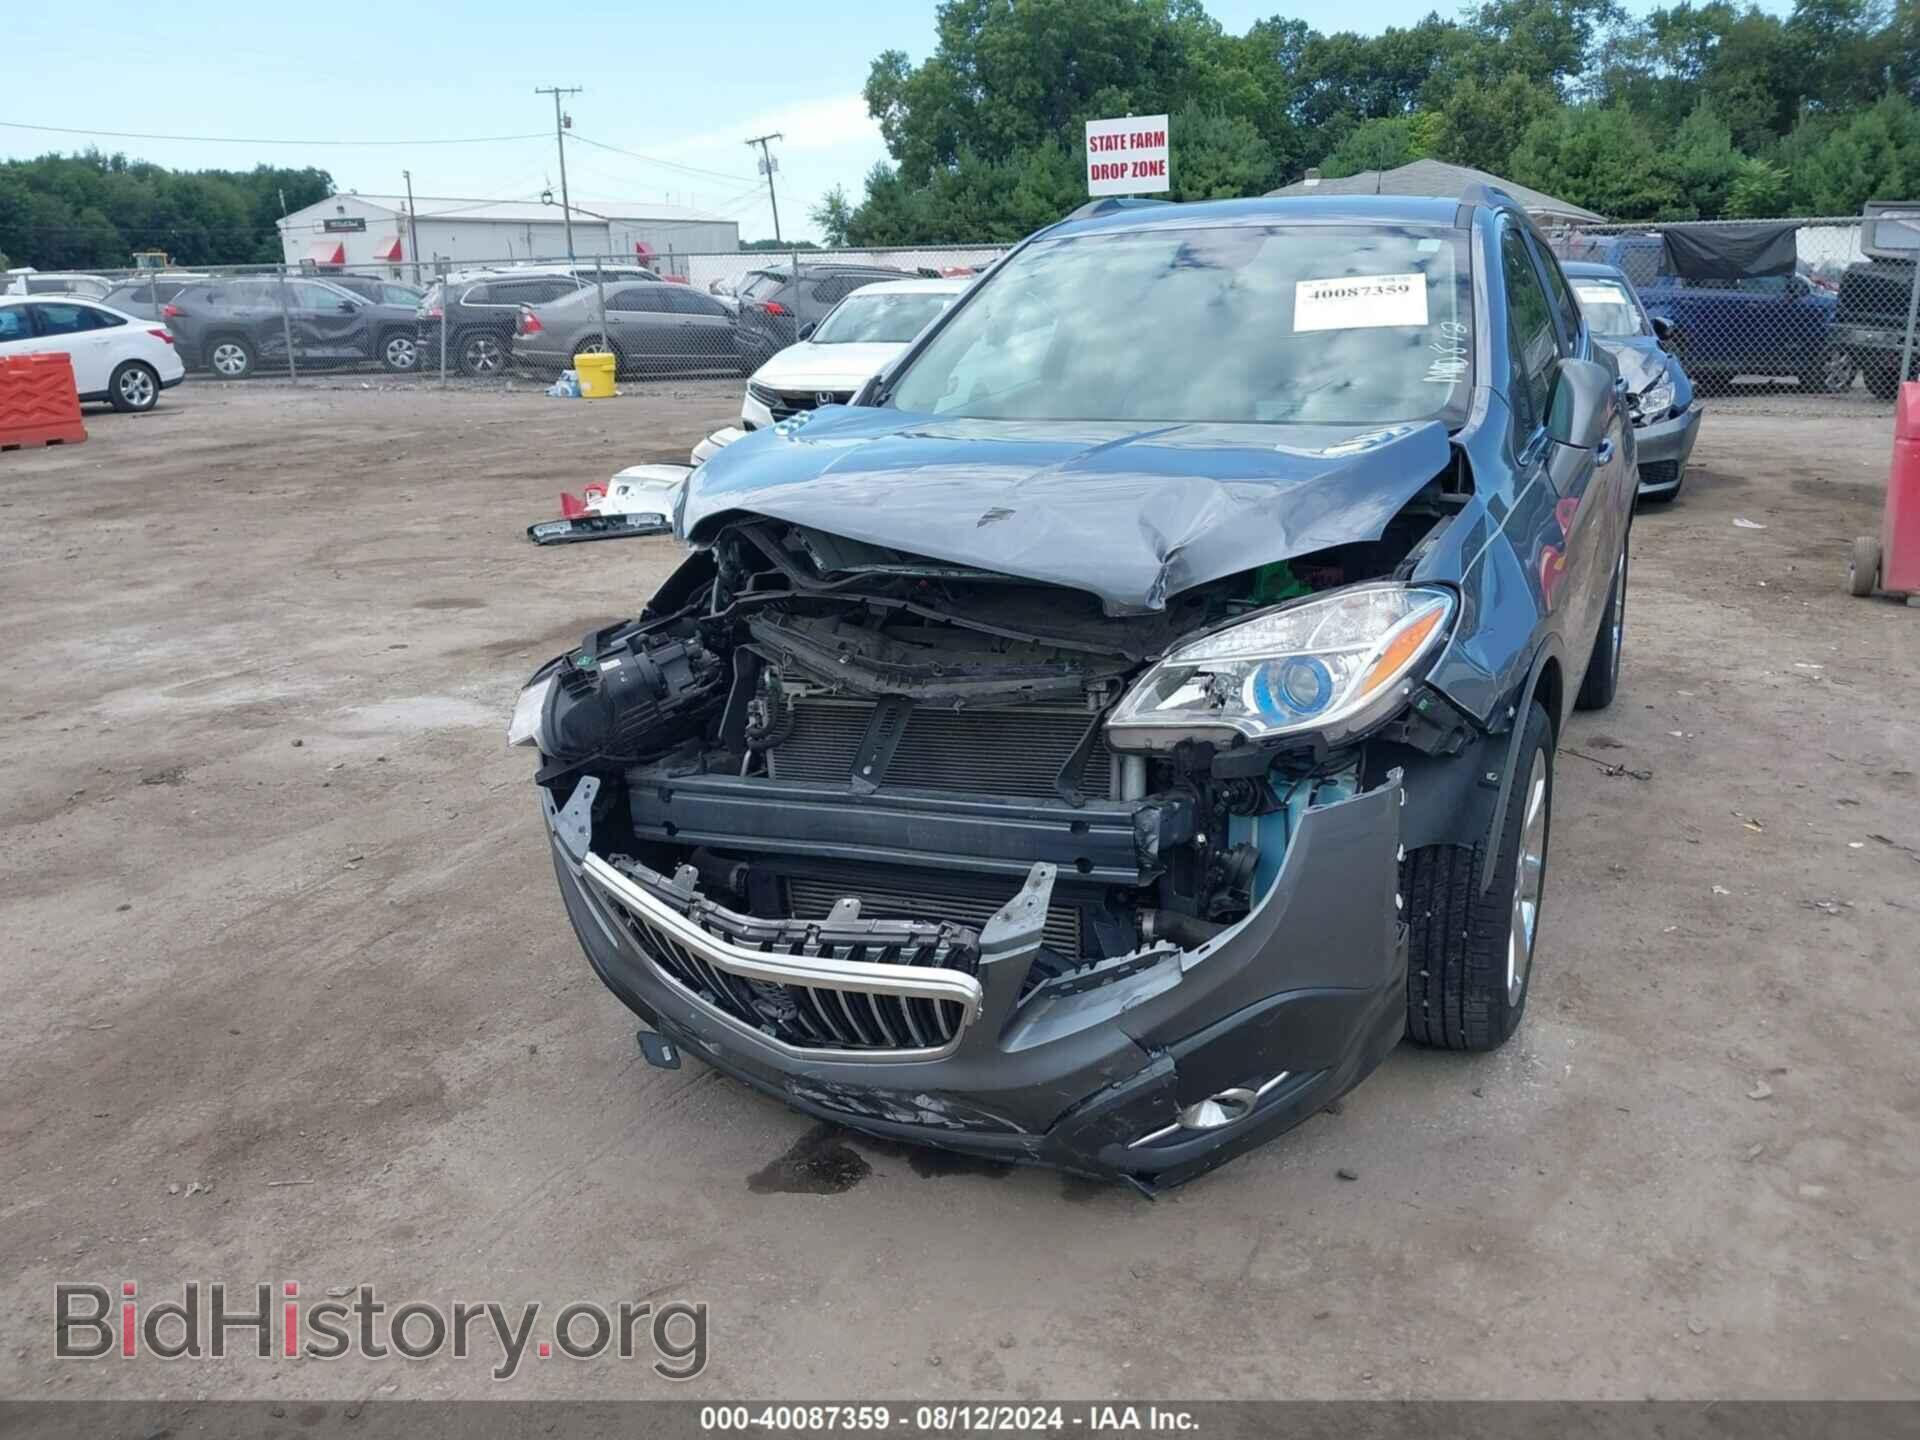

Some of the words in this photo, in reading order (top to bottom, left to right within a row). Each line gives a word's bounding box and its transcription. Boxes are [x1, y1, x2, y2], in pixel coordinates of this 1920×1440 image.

[1089, 133, 1127, 152] STATE
[1129, 130, 1165, 149] FARM
[1091, 162, 1128, 181] DROP
[1131, 159, 1166, 178] ZONE
[1307, 284, 1410, 299] 40087359
